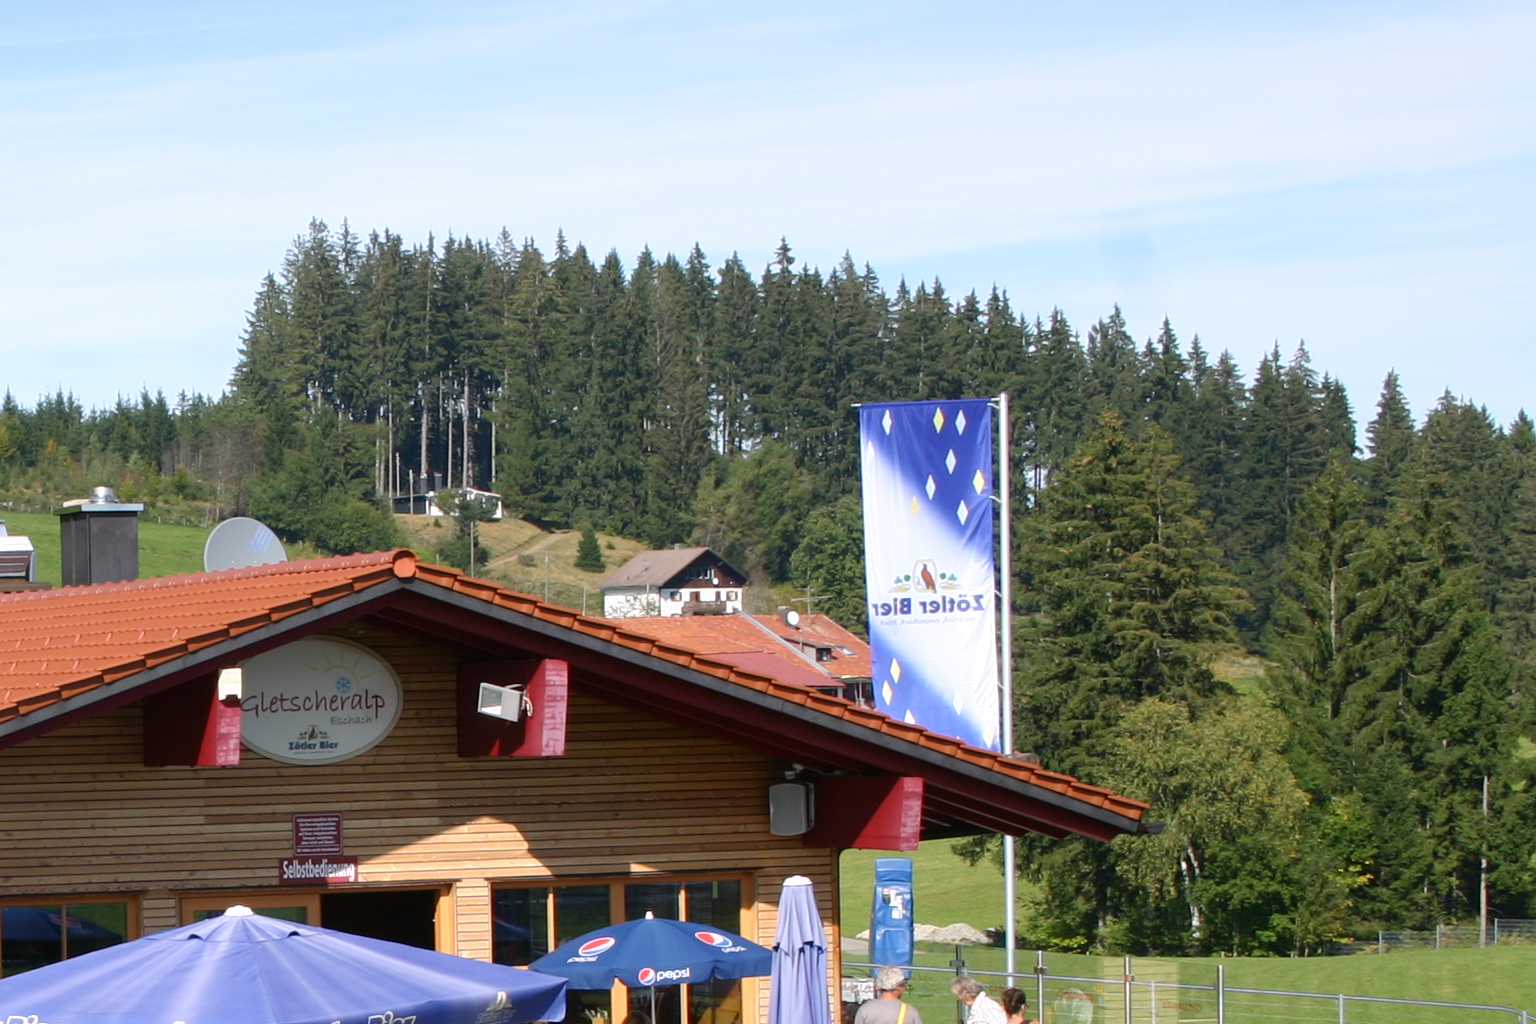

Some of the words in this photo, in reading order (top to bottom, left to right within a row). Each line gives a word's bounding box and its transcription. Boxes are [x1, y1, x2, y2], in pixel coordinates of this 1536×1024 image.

[240, 689, 386, 719] Gletscheralp
[330, 715, 373, 726] Eschach
[319, 741, 339, 750] Bier
[282, 858, 356, 882] Selbstbedienung
[656, 967, 690, 981] pepsi
